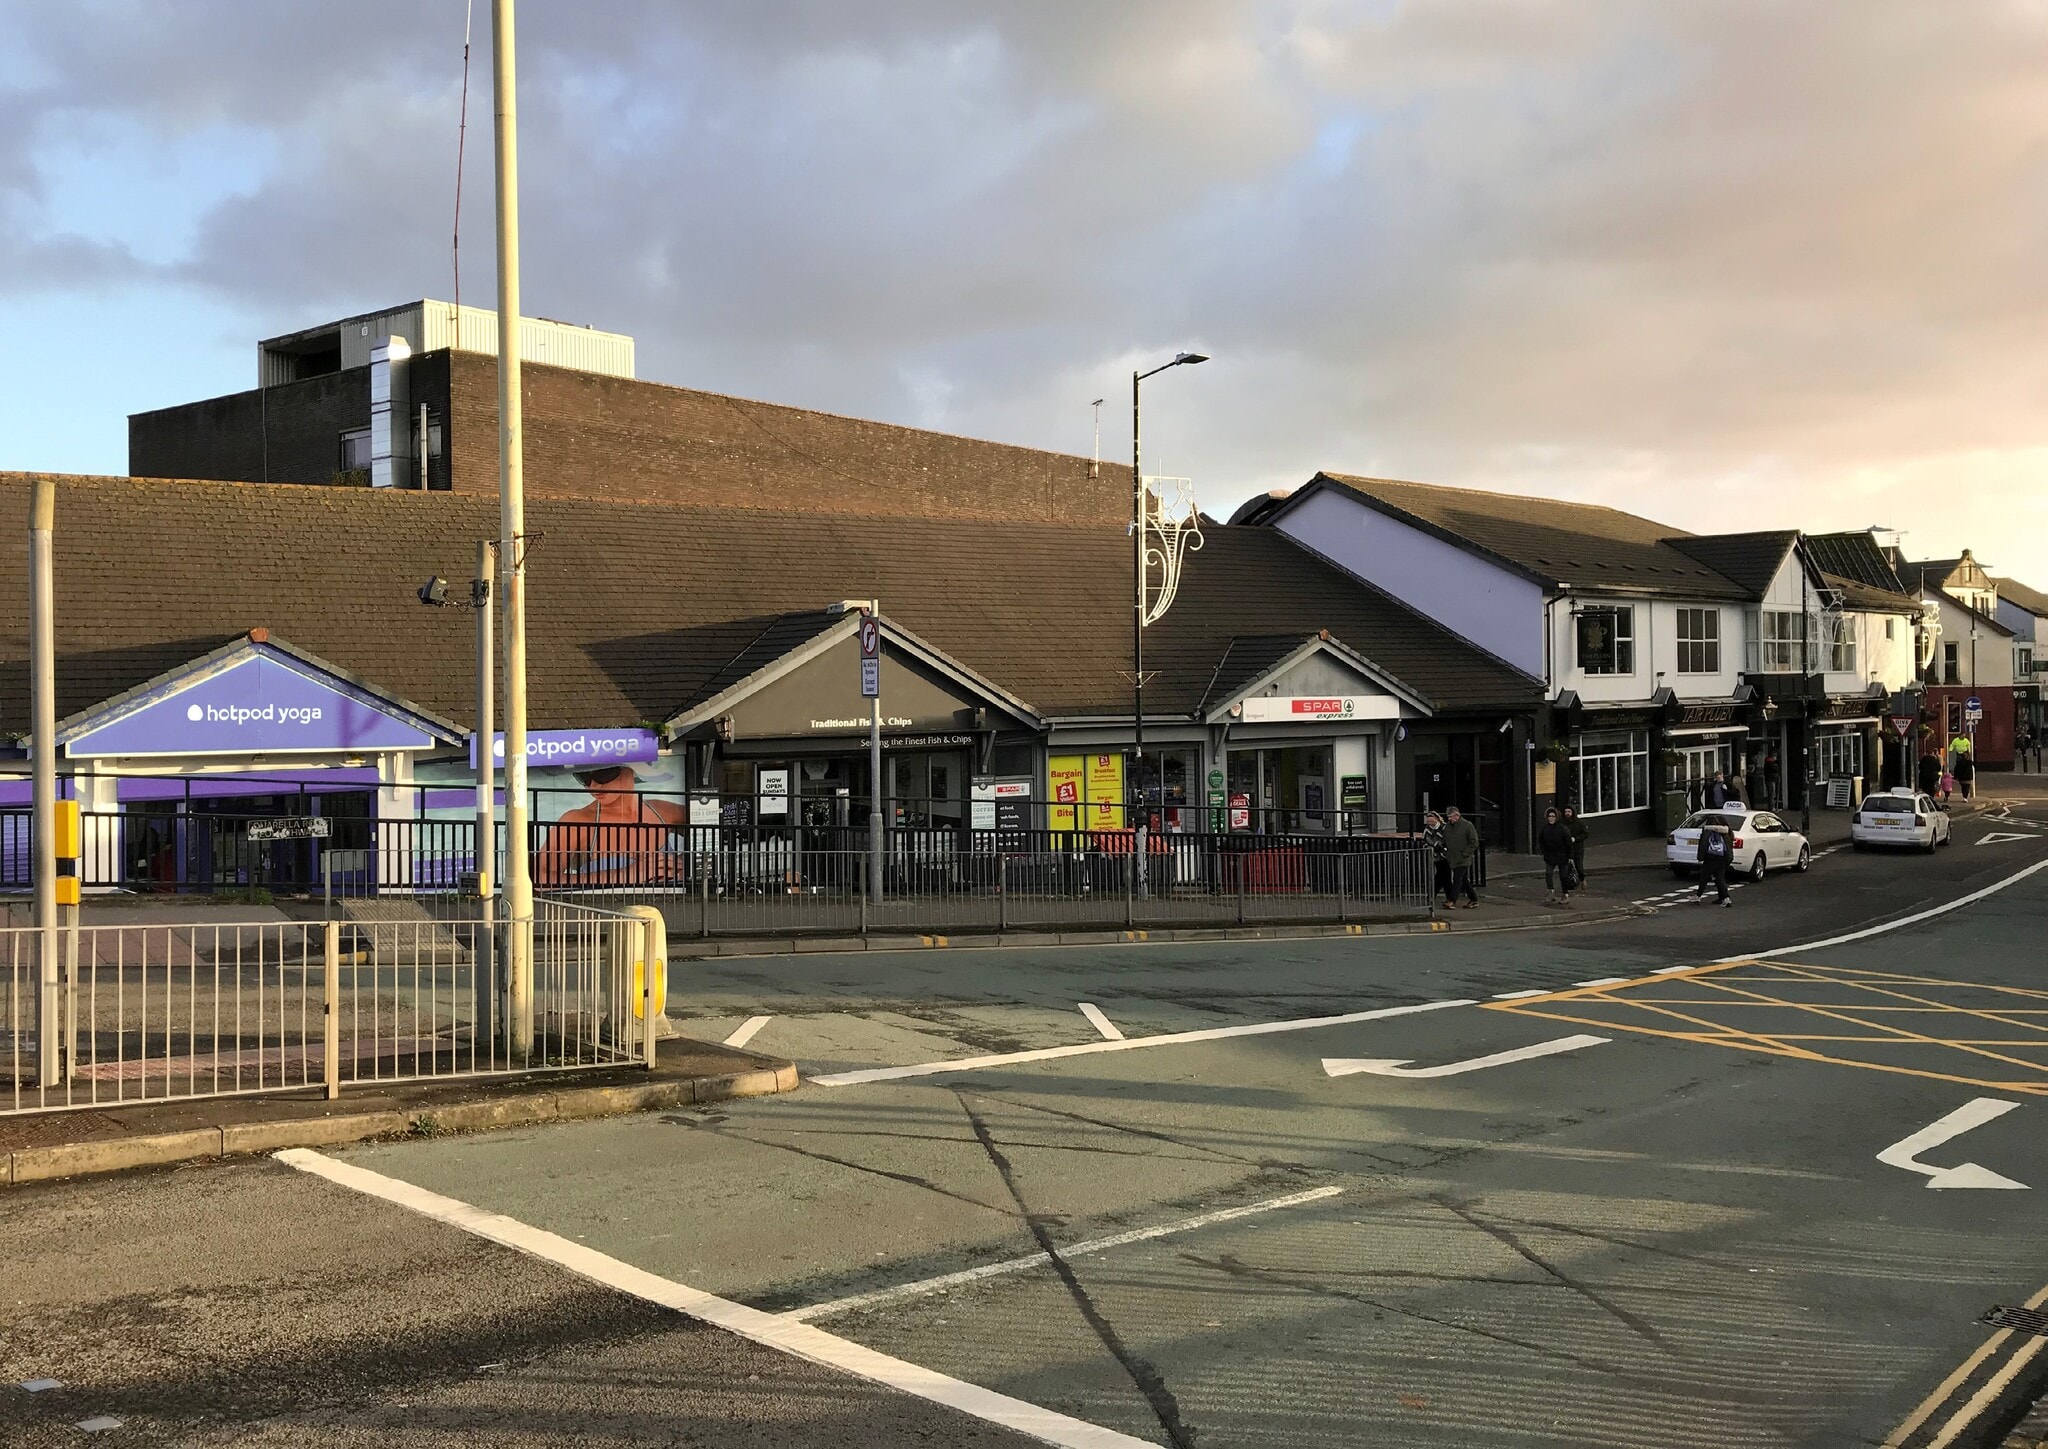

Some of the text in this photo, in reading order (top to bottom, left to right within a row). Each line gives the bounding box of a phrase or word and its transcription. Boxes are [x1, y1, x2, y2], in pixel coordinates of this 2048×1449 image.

[1303, 701, 1341, 712] SPAR
[207, 703, 322, 725] hotpod yoga
[1316, 711, 1354, 719] express
[810, 717, 857, 729] Traditional
[888, 716, 912, 728] Chips
[891, 735, 903, 745] the
[905, 734, 926, 745] Finest
[928, 734, 942, 744] Fish
[943, 735, 950, 744] &
[952, 734, 972, 745] Chips
[526, 735, 639, 760] otpod yoga
[1051, 769, 1083, 779] Bargain
[1060, 784, 1073, 797] £1
[1057, 809, 1074, 817] Bite
